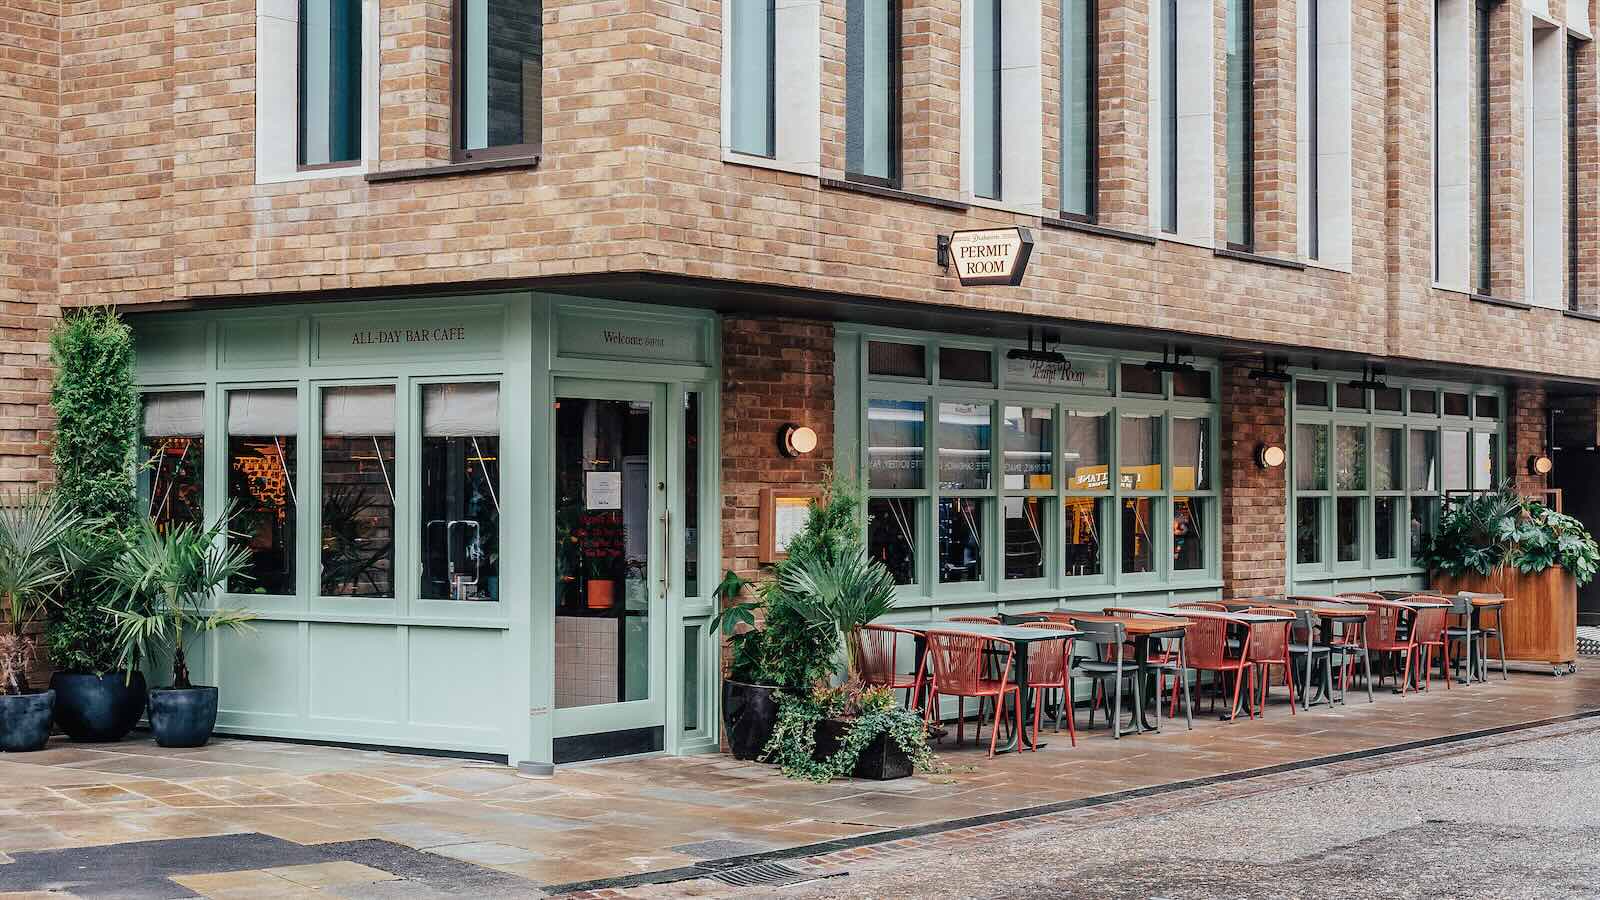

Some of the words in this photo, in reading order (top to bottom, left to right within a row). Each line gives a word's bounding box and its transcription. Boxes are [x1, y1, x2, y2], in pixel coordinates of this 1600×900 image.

[960, 244, 1009, 258] PERMIT
[967, 260, 1004, 274] ROOM
[352, 330, 402, 344] ALL-DAY
[406, 328, 430, 342] BAR
[603, 329, 643, 346] Welcome
[1061, 361, 1086, 383] Room
